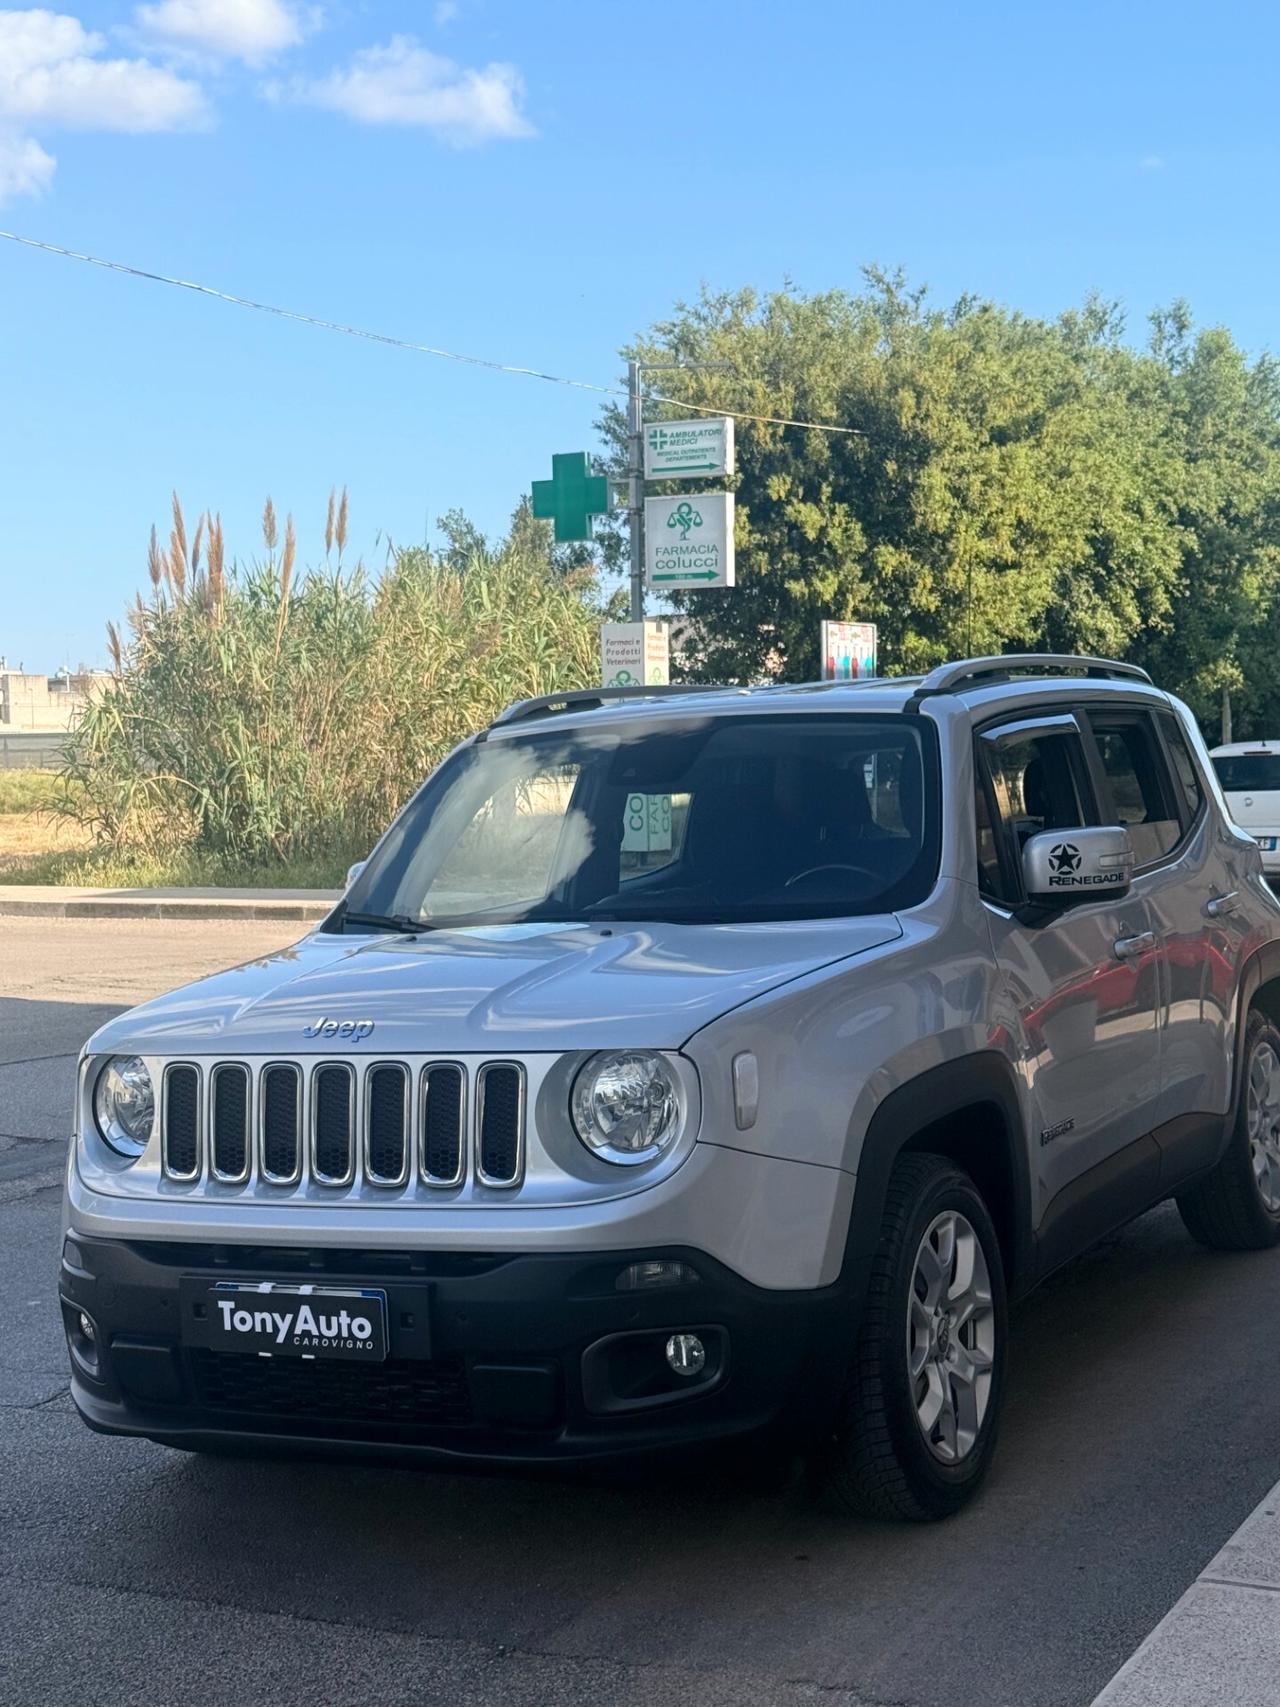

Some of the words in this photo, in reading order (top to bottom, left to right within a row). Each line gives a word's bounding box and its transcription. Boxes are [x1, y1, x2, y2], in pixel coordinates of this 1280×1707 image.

[669, 438, 698, 447] MEDICI
[655, 544, 719, 557] FARMACIA
[606, 637, 634, 646] Farmaci
[606, 647, 641, 656] Prodotti
[606, 657, 641, 666] Veterinari
[1048, 872, 1124, 887] RENEGADE
[302, 1016, 375, 1043] Jeep
[217, 1300, 373, 1344] TonyAuto
[293, 1336, 374, 1350] CAROVIGNO
